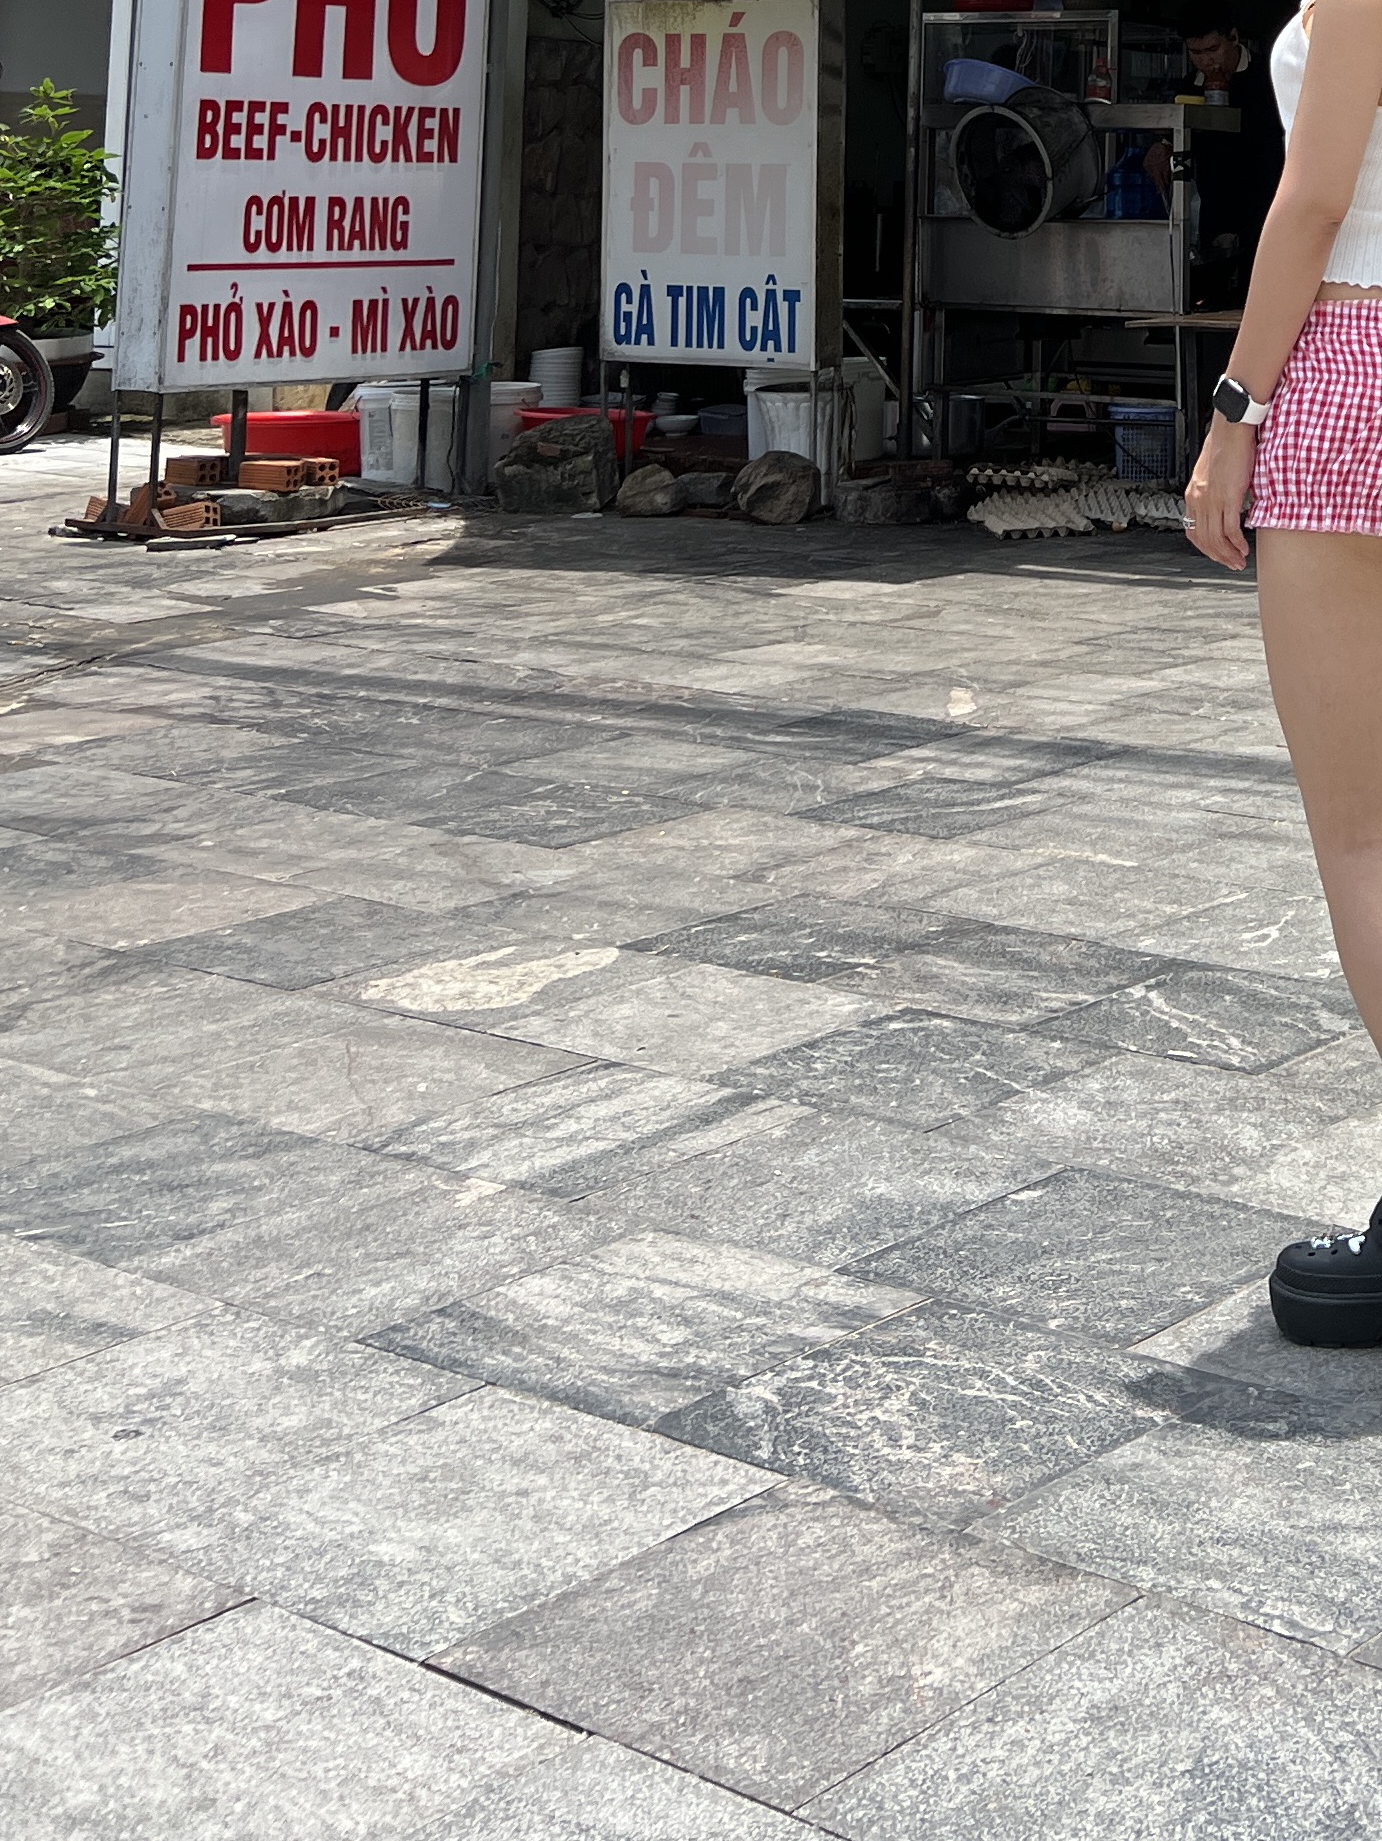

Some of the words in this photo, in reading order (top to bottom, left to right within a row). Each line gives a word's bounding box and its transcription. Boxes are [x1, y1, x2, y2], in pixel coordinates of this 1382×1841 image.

[616, 11, 806, 127] CHÁO
[195, 98, 462, 165] BEEF-CHICKEN
[243, 193, 315, 254] CƠM
[325, 194, 411, 252] RANG
[630, 141, 789, 257] ĐÊM
[176, 281, 244, 363] PHỞ
[253, 289, 319, 360] XÀO
[350, 286, 390, 356] MÌ
[399, 284, 460, 353] XÀO
[612, 269, 656, 348] GÀ
[666, 284, 727, 351] TIM
[738, 273, 802, 363] CẬT
